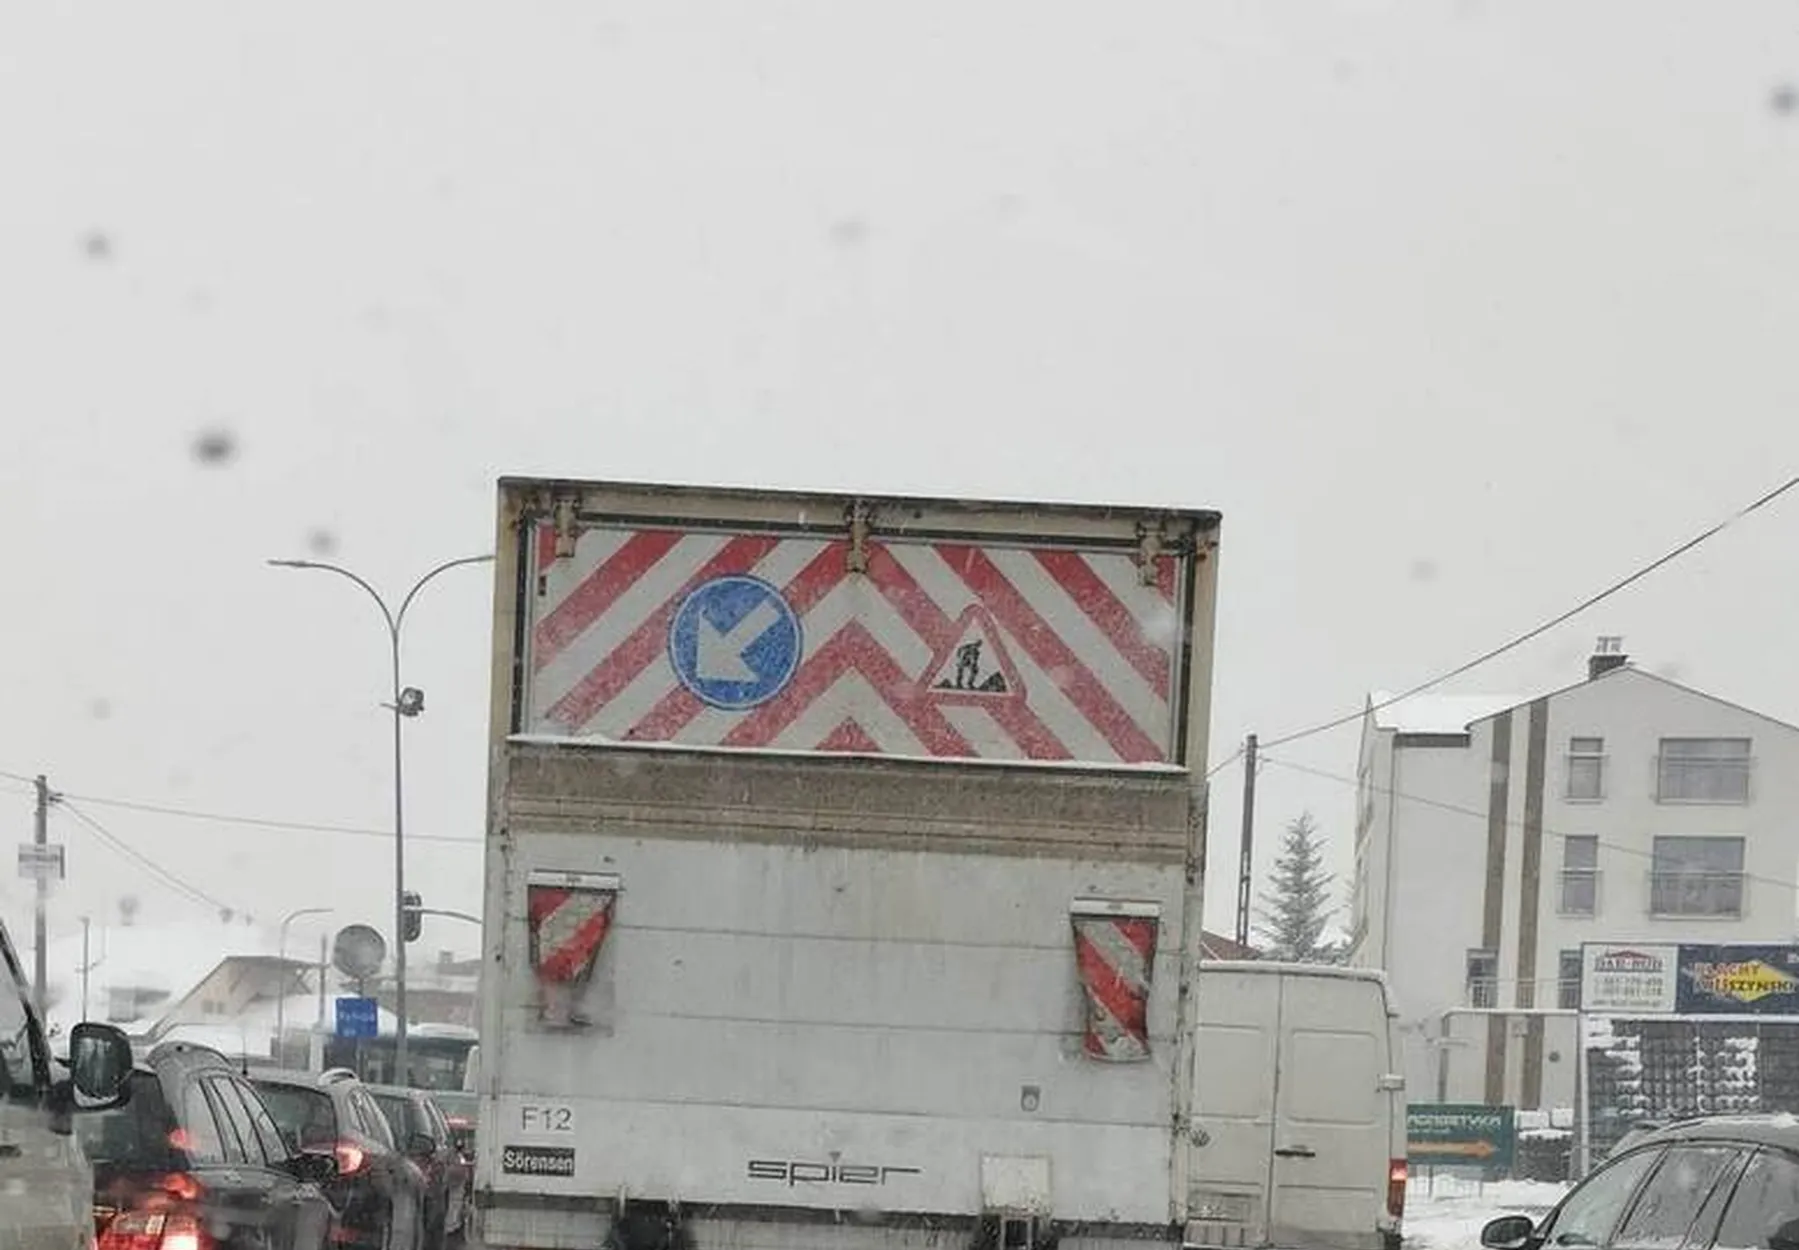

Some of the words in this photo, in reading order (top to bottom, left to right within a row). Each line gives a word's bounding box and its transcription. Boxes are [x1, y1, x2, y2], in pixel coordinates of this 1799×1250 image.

[521, 1106, 573, 1131] F12
[503, 1150, 573, 1173] Sörensen
[748, 1152, 921, 1187] spier
